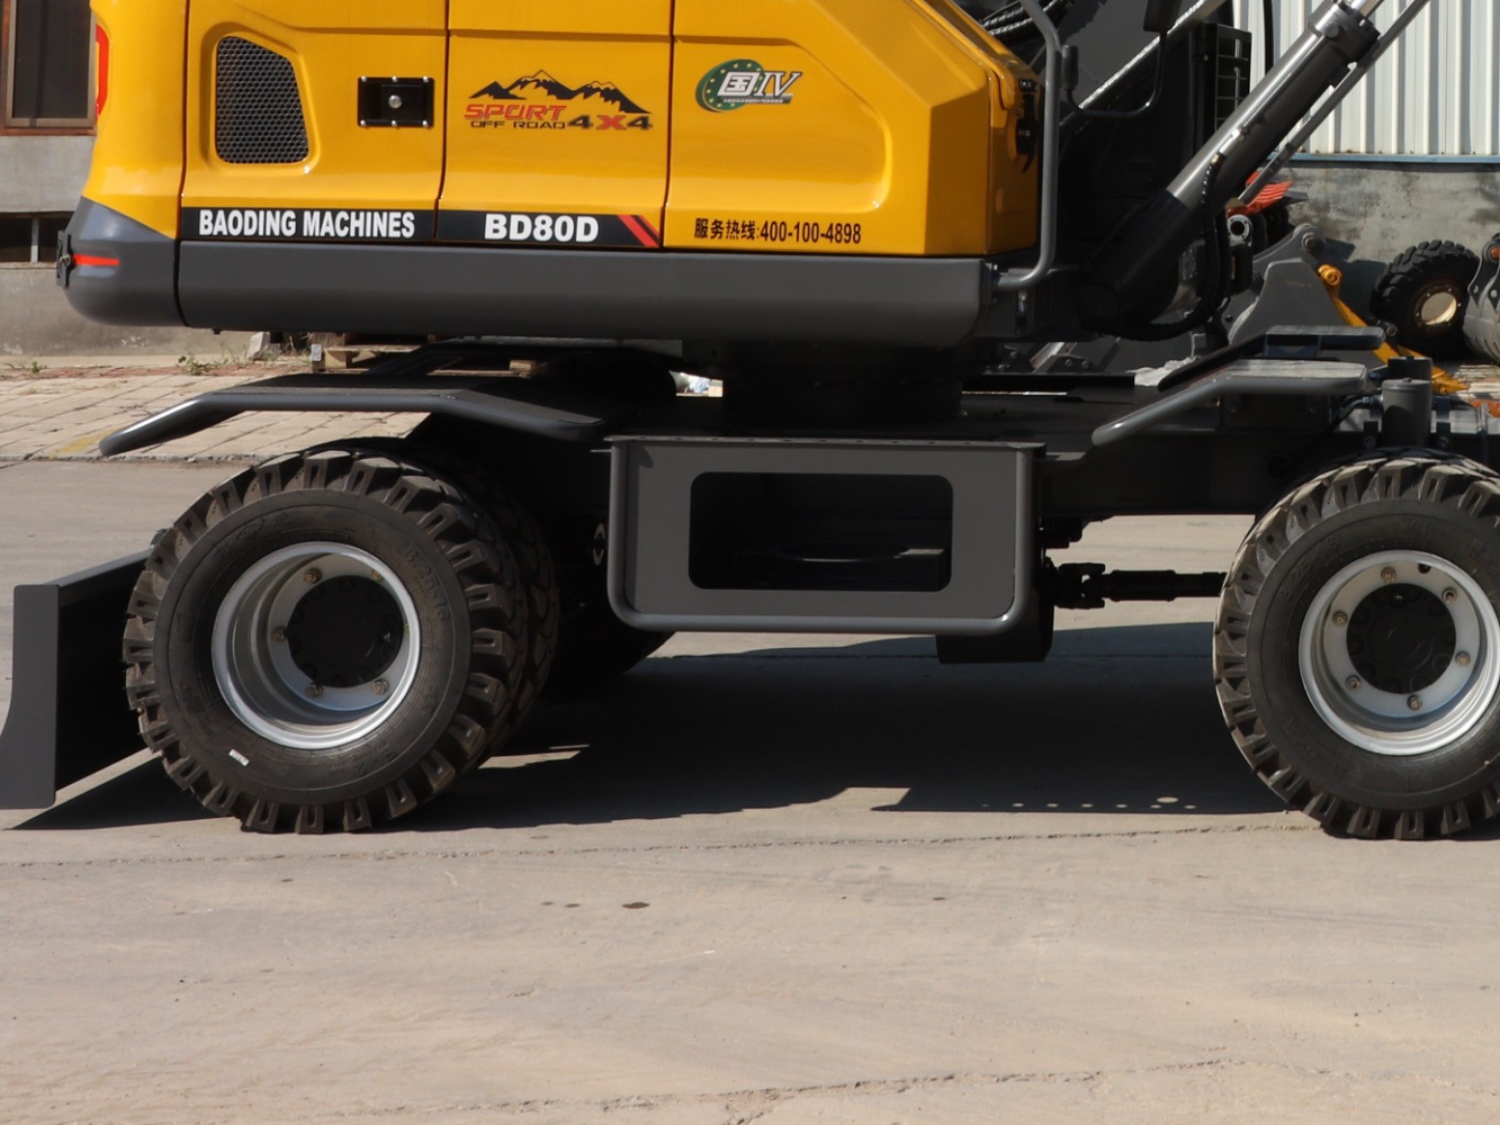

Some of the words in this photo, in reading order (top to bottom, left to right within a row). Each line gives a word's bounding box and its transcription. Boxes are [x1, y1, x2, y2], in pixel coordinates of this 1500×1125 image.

[464, 104, 567, 121] SPORT
[470, 121, 505, 129] OFF
[513, 121, 565, 130] ROAD
[199, 209, 297, 237] BAODING
[303, 211, 415, 238] MACHINES
[485, 213, 599, 243] BD80D
